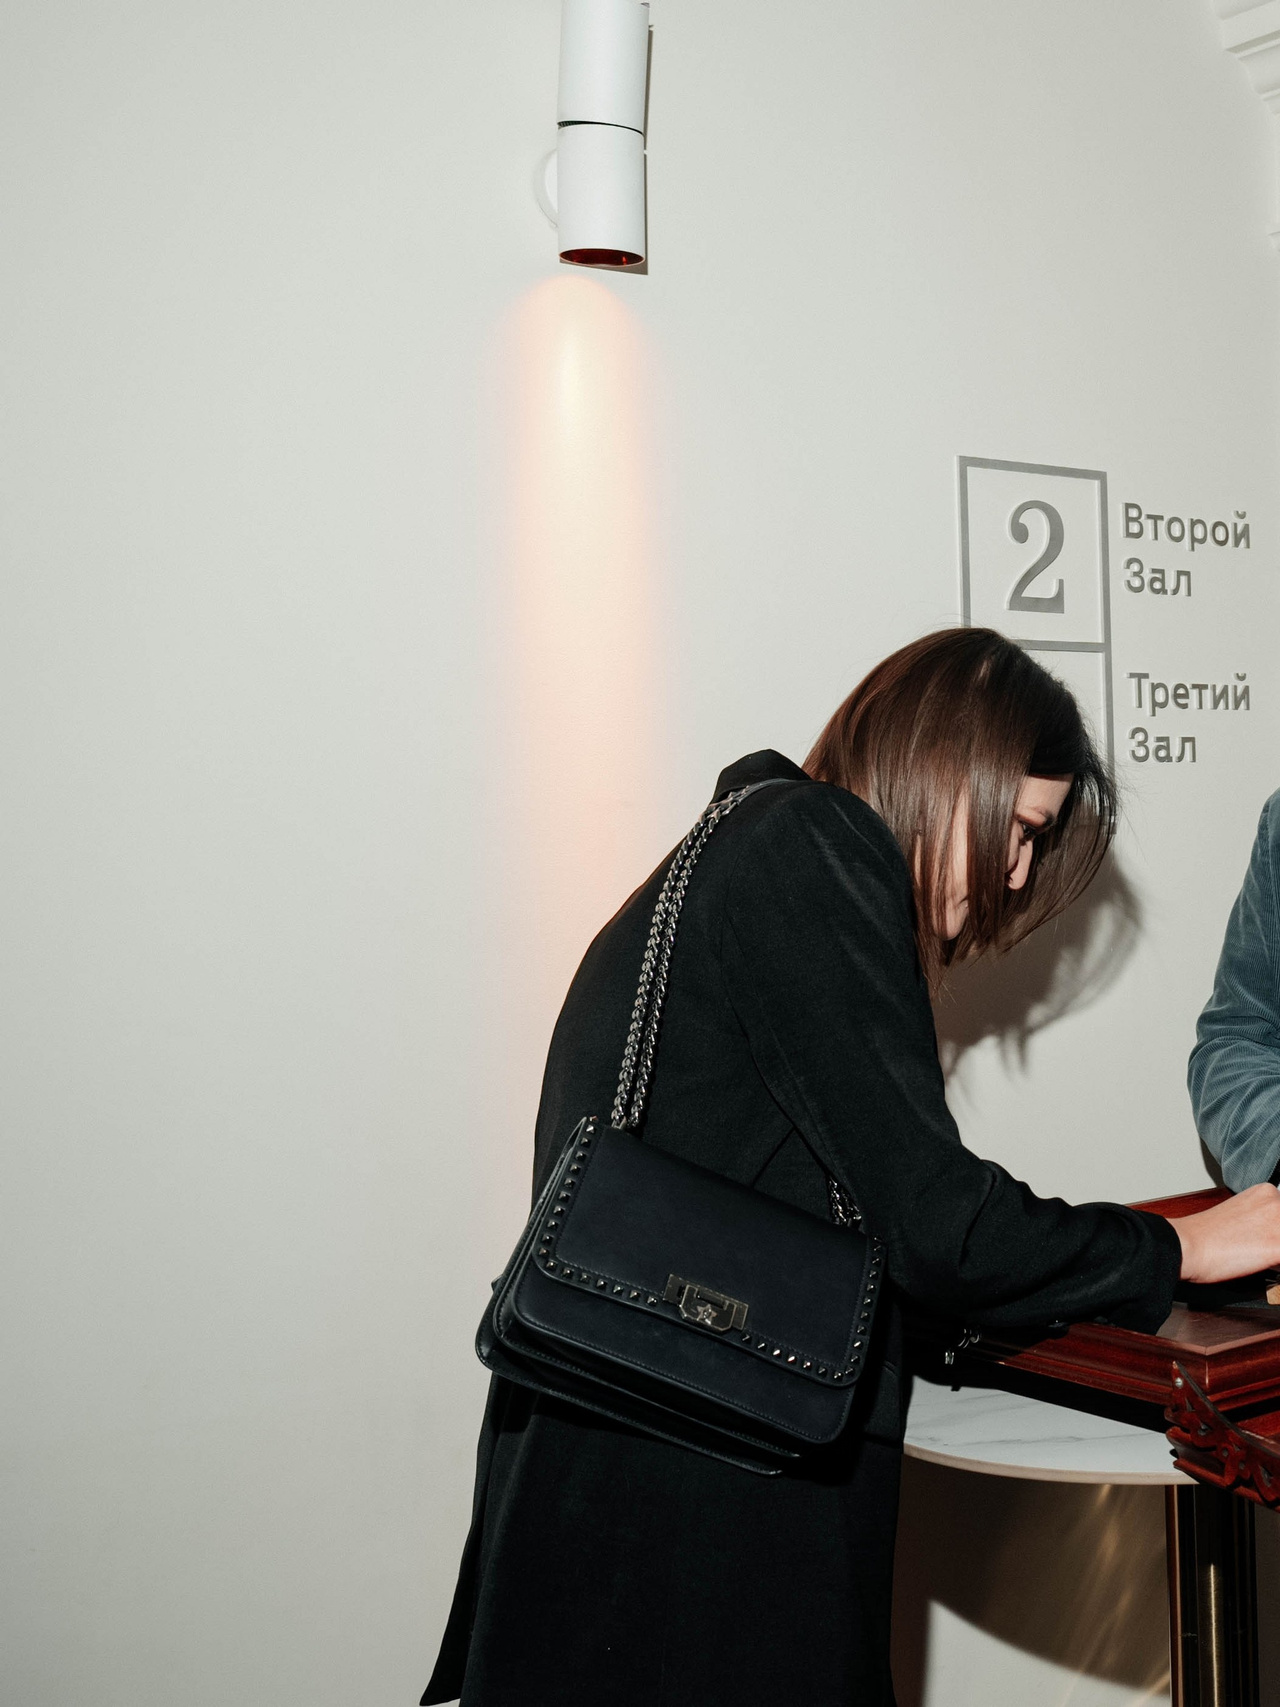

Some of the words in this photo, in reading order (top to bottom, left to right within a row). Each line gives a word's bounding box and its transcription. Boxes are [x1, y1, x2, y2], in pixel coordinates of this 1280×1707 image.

[1122, 502, 1251, 551] Второй
[1006, 499, 1065, 614] 2
[1124, 557, 1192, 597] Зал
[1127, 672, 1251, 717] Третий
[1129, 726, 1197, 763] Зал
